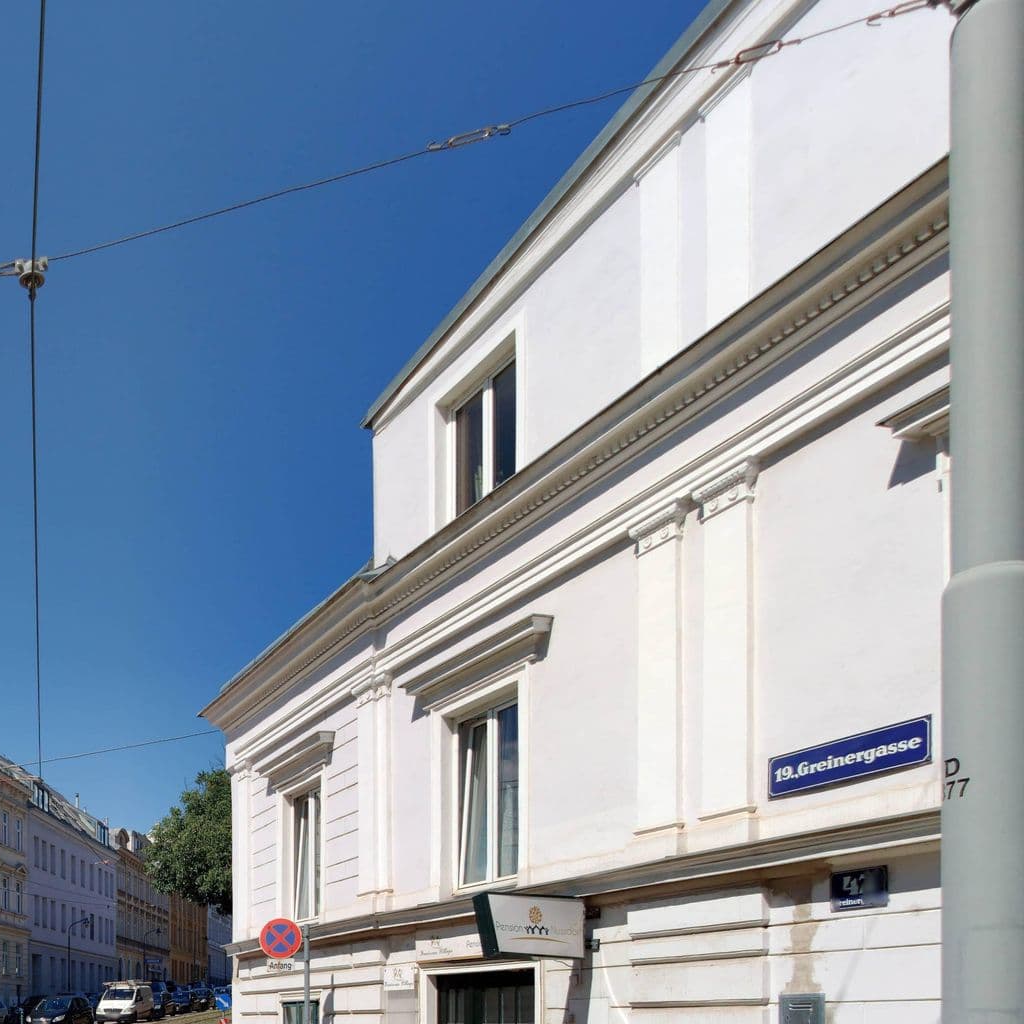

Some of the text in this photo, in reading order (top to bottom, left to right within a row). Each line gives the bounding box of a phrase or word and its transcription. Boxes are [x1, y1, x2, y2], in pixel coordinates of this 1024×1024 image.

[944, 777, 970, 800] 77
[495, 920, 523, 933] Pension
[269, 961, 291, 971] Anfang
